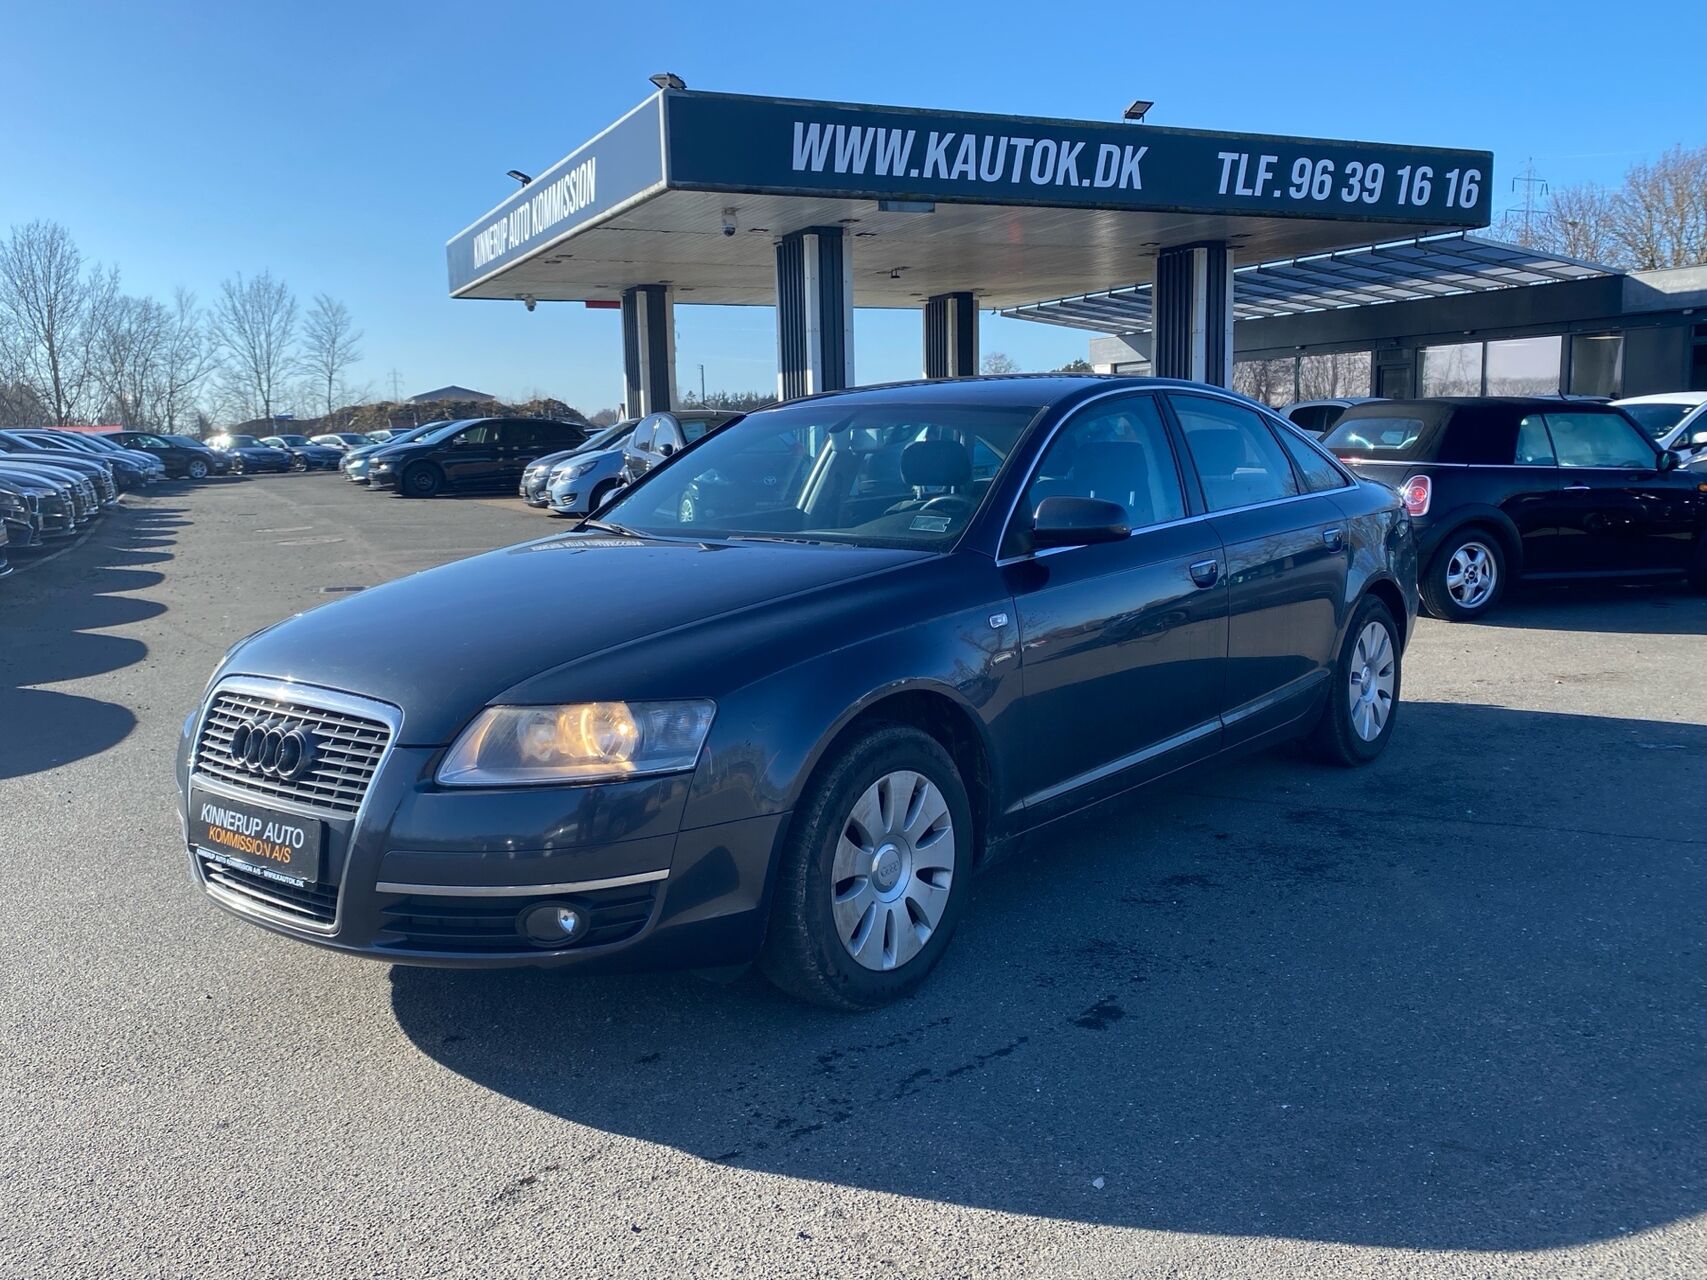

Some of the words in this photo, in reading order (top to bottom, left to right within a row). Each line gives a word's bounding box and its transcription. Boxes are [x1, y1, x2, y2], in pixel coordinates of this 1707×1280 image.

[791, 121, 1148, 190] WWW.KAUTOK.DK
[1217, 151, 1282, 198] TLF.
[1288, 156, 1335, 202] 96
[1340, 161, 1385, 205] 39
[1396, 165, 1433, 206] 16
[1444, 168, 1482, 209] 16
[473, 216, 508, 271] KINNERUP
[508, 201, 530, 250] AUTO
[531, 156, 597, 237] KOMMISSION
[200, 803, 263, 837] KINNERUP
[262, 821, 305, 849] AUTO
[208, 825, 271, 859] KOMMISSION
[272, 846, 292, 864] A/S
